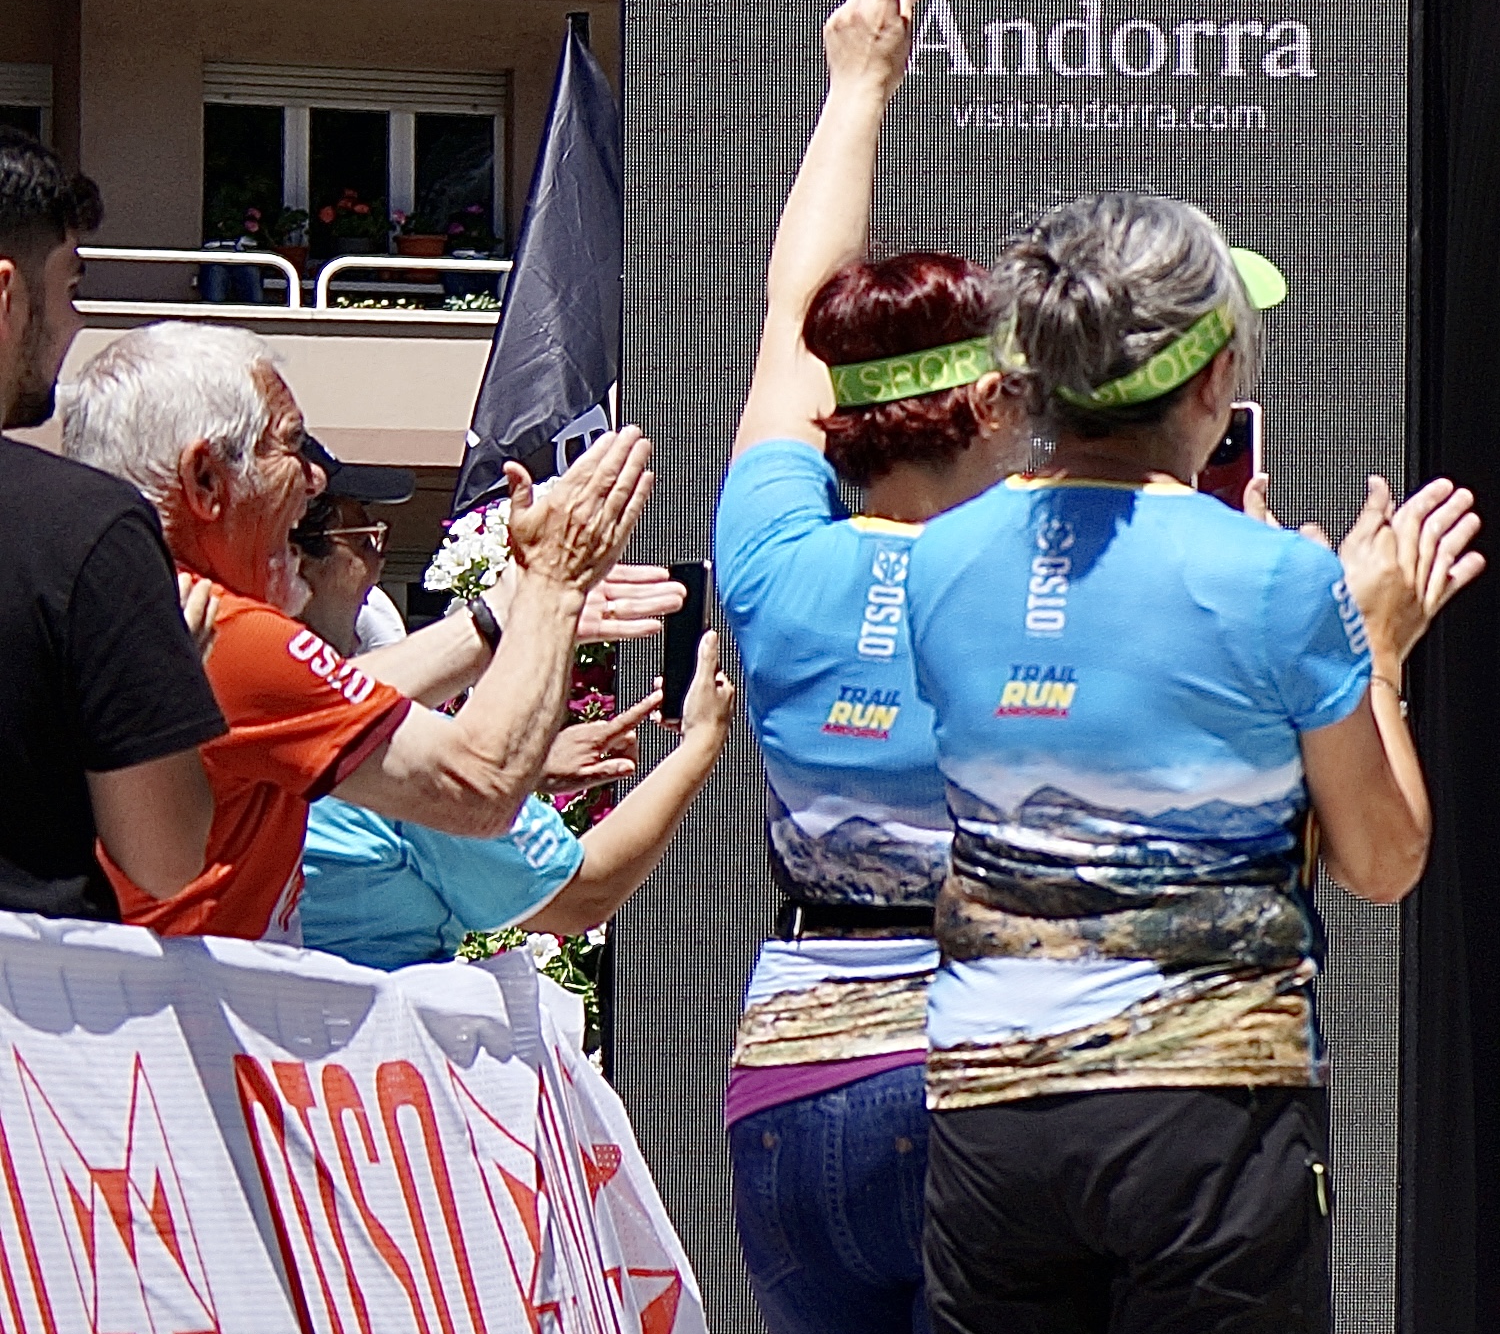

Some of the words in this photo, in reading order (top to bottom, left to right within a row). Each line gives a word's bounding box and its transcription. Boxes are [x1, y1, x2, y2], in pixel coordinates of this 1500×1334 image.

[953, 97, 1267, 129] visitandorra.com
[1025, 556, 1072, 632] OTSO
[857, 584, 906, 659] OTSO
[1008, 664, 1079, 683] TRAIL
[833, 685, 901, 707] TRAIL
[1000, 681, 1079, 708] RUN
[830, 701, 899, 729] RUN
